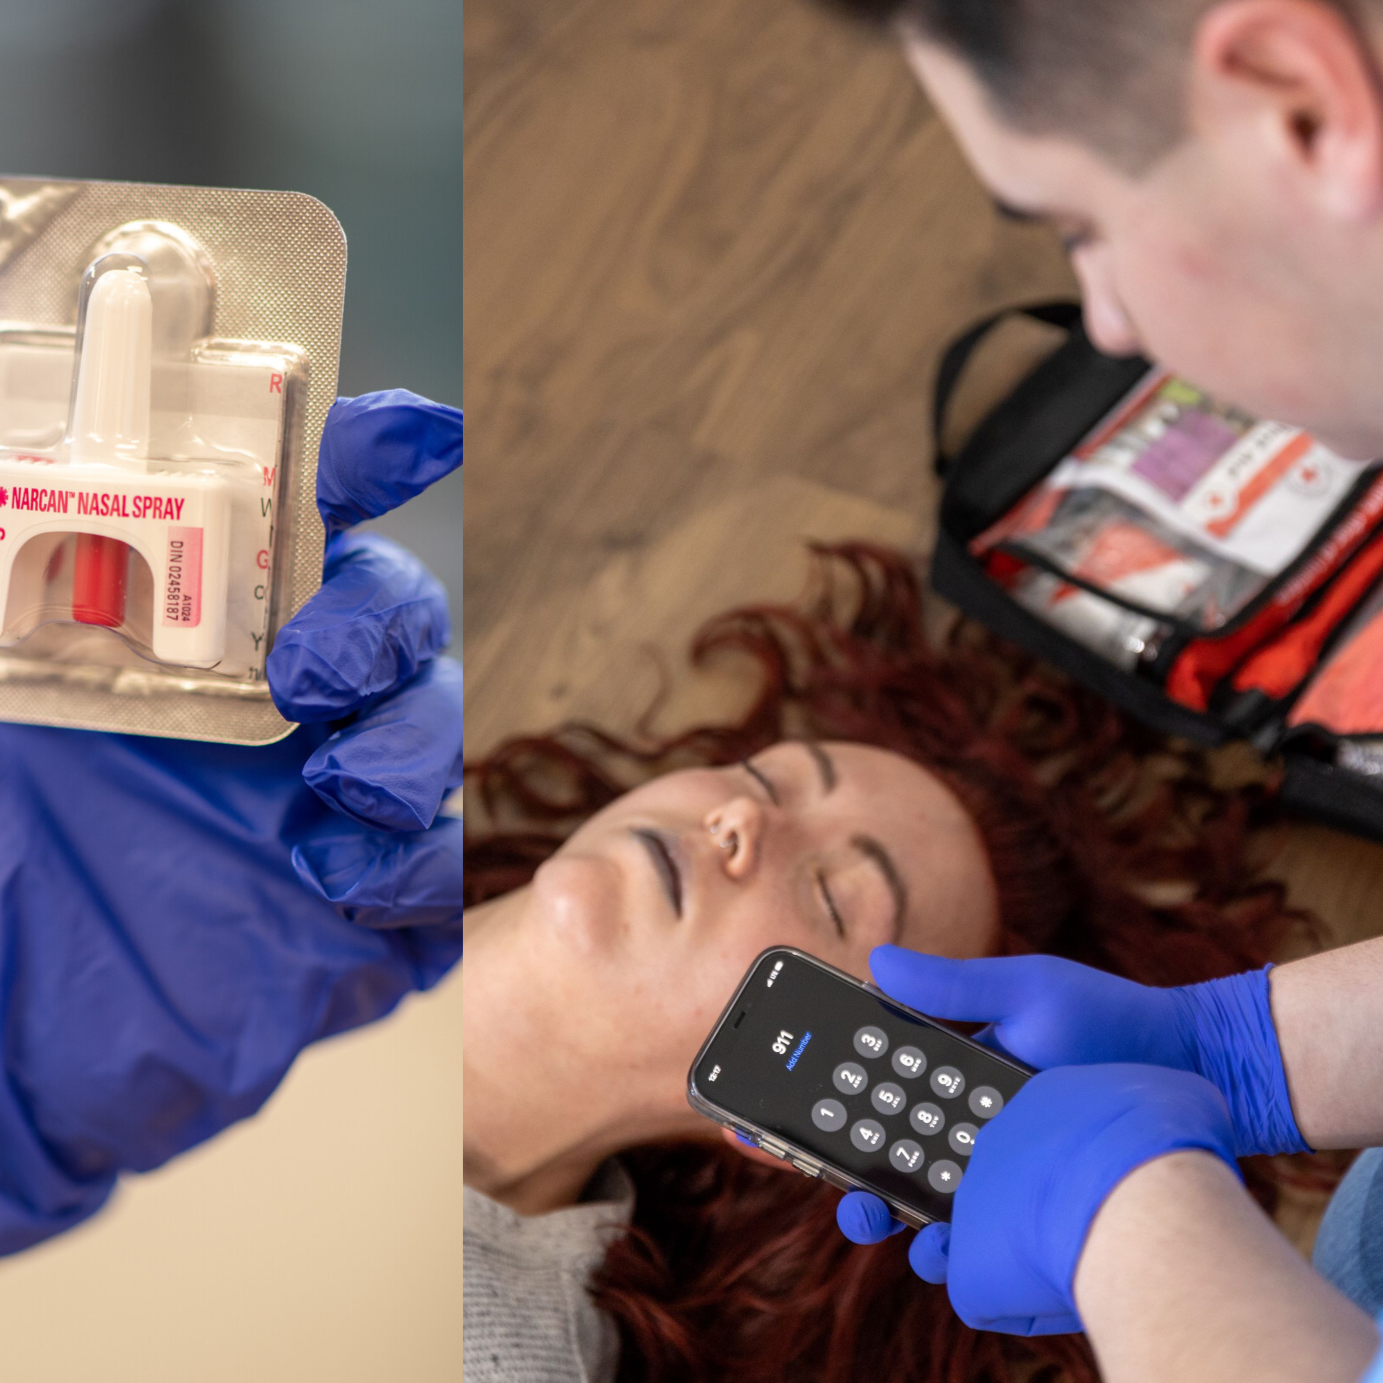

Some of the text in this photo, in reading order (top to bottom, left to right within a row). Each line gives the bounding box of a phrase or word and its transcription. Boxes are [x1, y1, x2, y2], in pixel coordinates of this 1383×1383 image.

[77, 491, 130, 518] NASAL
[132, 495, 185, 521] SPRAY
[166, 540, 184, 621] DIN 02458187
[181, 594, 192, 622] A1024
[772, 1030, 794, 1055] 911
[861, 1033, 876, 1047] 3
[785, 1031, 812, 1072] Add Number
[899, 1053, 914, 1067] 6
[708, 1064, 721, 1082] 12:17
[840, 1070, 856, 1084] 2
[937, 1073, 952, 1087] 9
[878, 1089, 894, 1103] 5
[820, 1107, 835, 1118] 1
[917, 1110, 932, 1124] 8
[859, 1127, 873, 1140] 4
[956, 1130, 971, 1144] 0
[896, 1147, 910, 1160] 7
